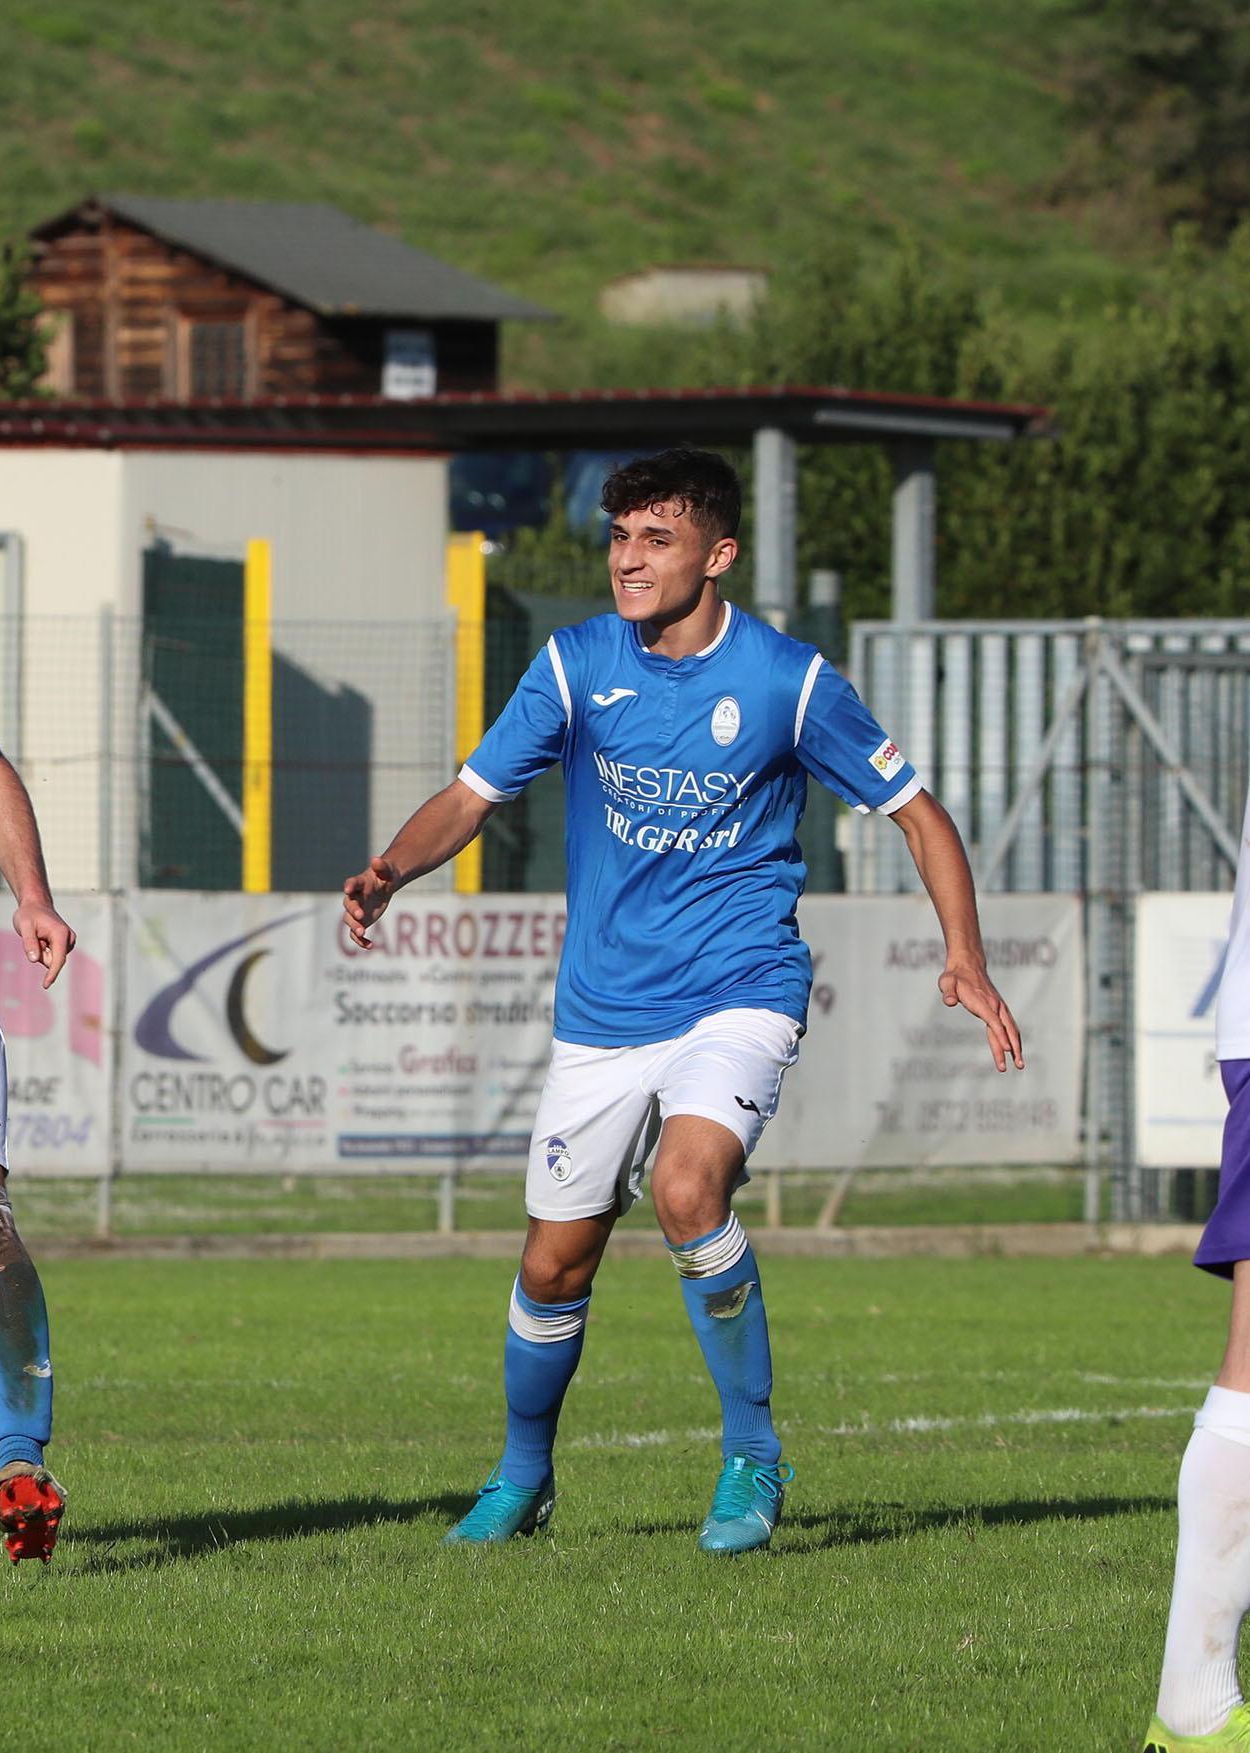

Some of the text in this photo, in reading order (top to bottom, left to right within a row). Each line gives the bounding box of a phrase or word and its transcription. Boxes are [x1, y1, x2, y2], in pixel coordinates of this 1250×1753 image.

[593, 751, 756, 804] INESTASY
[601, 785, 651, 814] CREATORI
[657, 808, 672, 817] DI
[604, 803, 699, 855] TRI.GER
[334, 991, 458, 1027] Soccorso
[130, 1071, 328, 1116] CENTRO CAR
